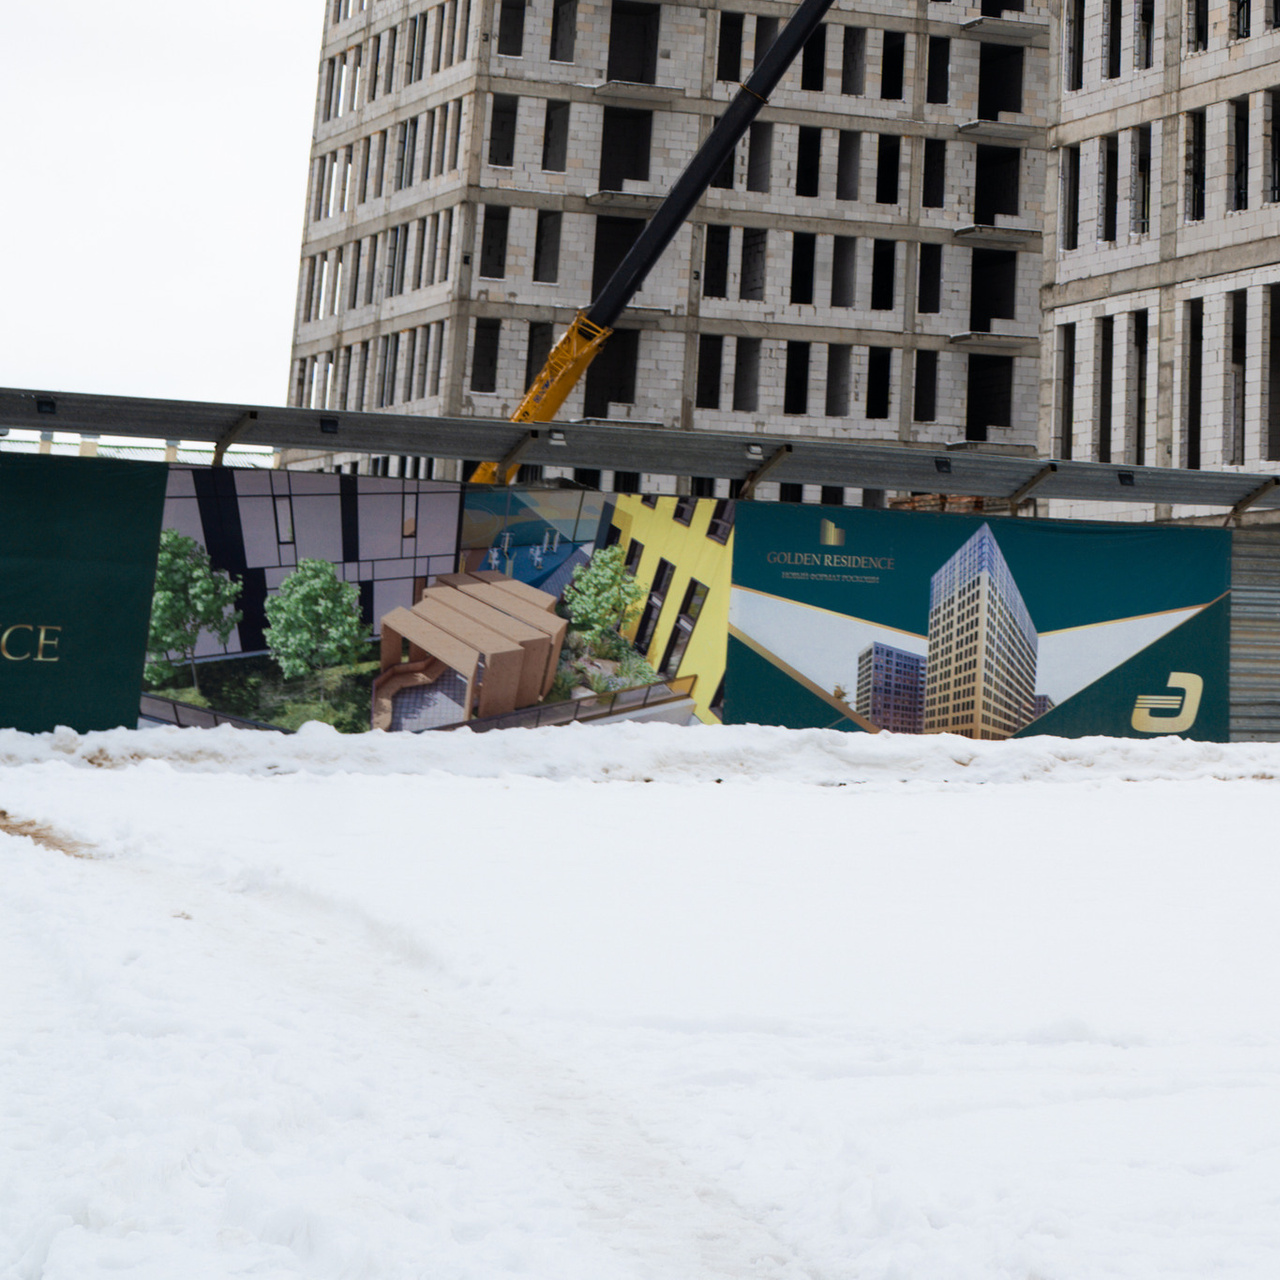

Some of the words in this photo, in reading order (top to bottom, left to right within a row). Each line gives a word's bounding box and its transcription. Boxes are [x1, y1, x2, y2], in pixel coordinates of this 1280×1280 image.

[766, 551, 821, 566] GOLDEN
[823, 554, 895, 570] RESIDENCE
[0, 624, 62, 662] CE
